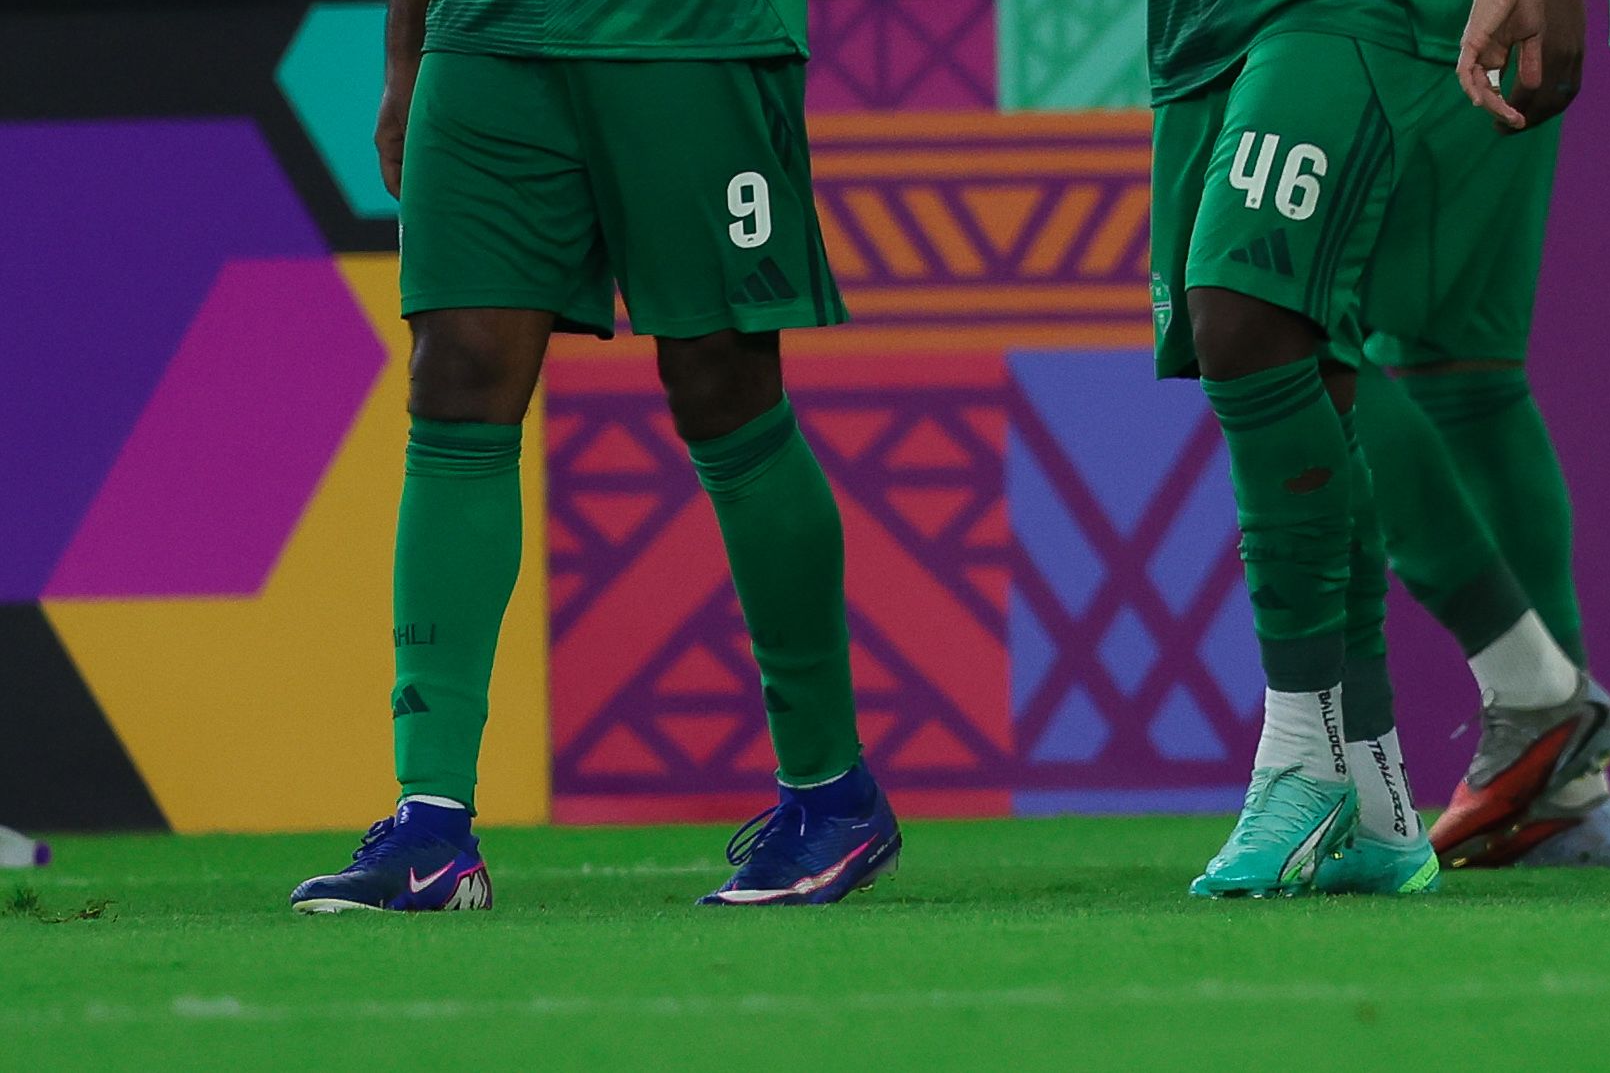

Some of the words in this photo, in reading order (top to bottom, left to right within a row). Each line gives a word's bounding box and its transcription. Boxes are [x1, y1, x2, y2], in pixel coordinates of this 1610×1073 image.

[726, 171, 772, 249] 9
[1229, 131, 1329, 221] 46
[392, 622, 436, 648] HLI
